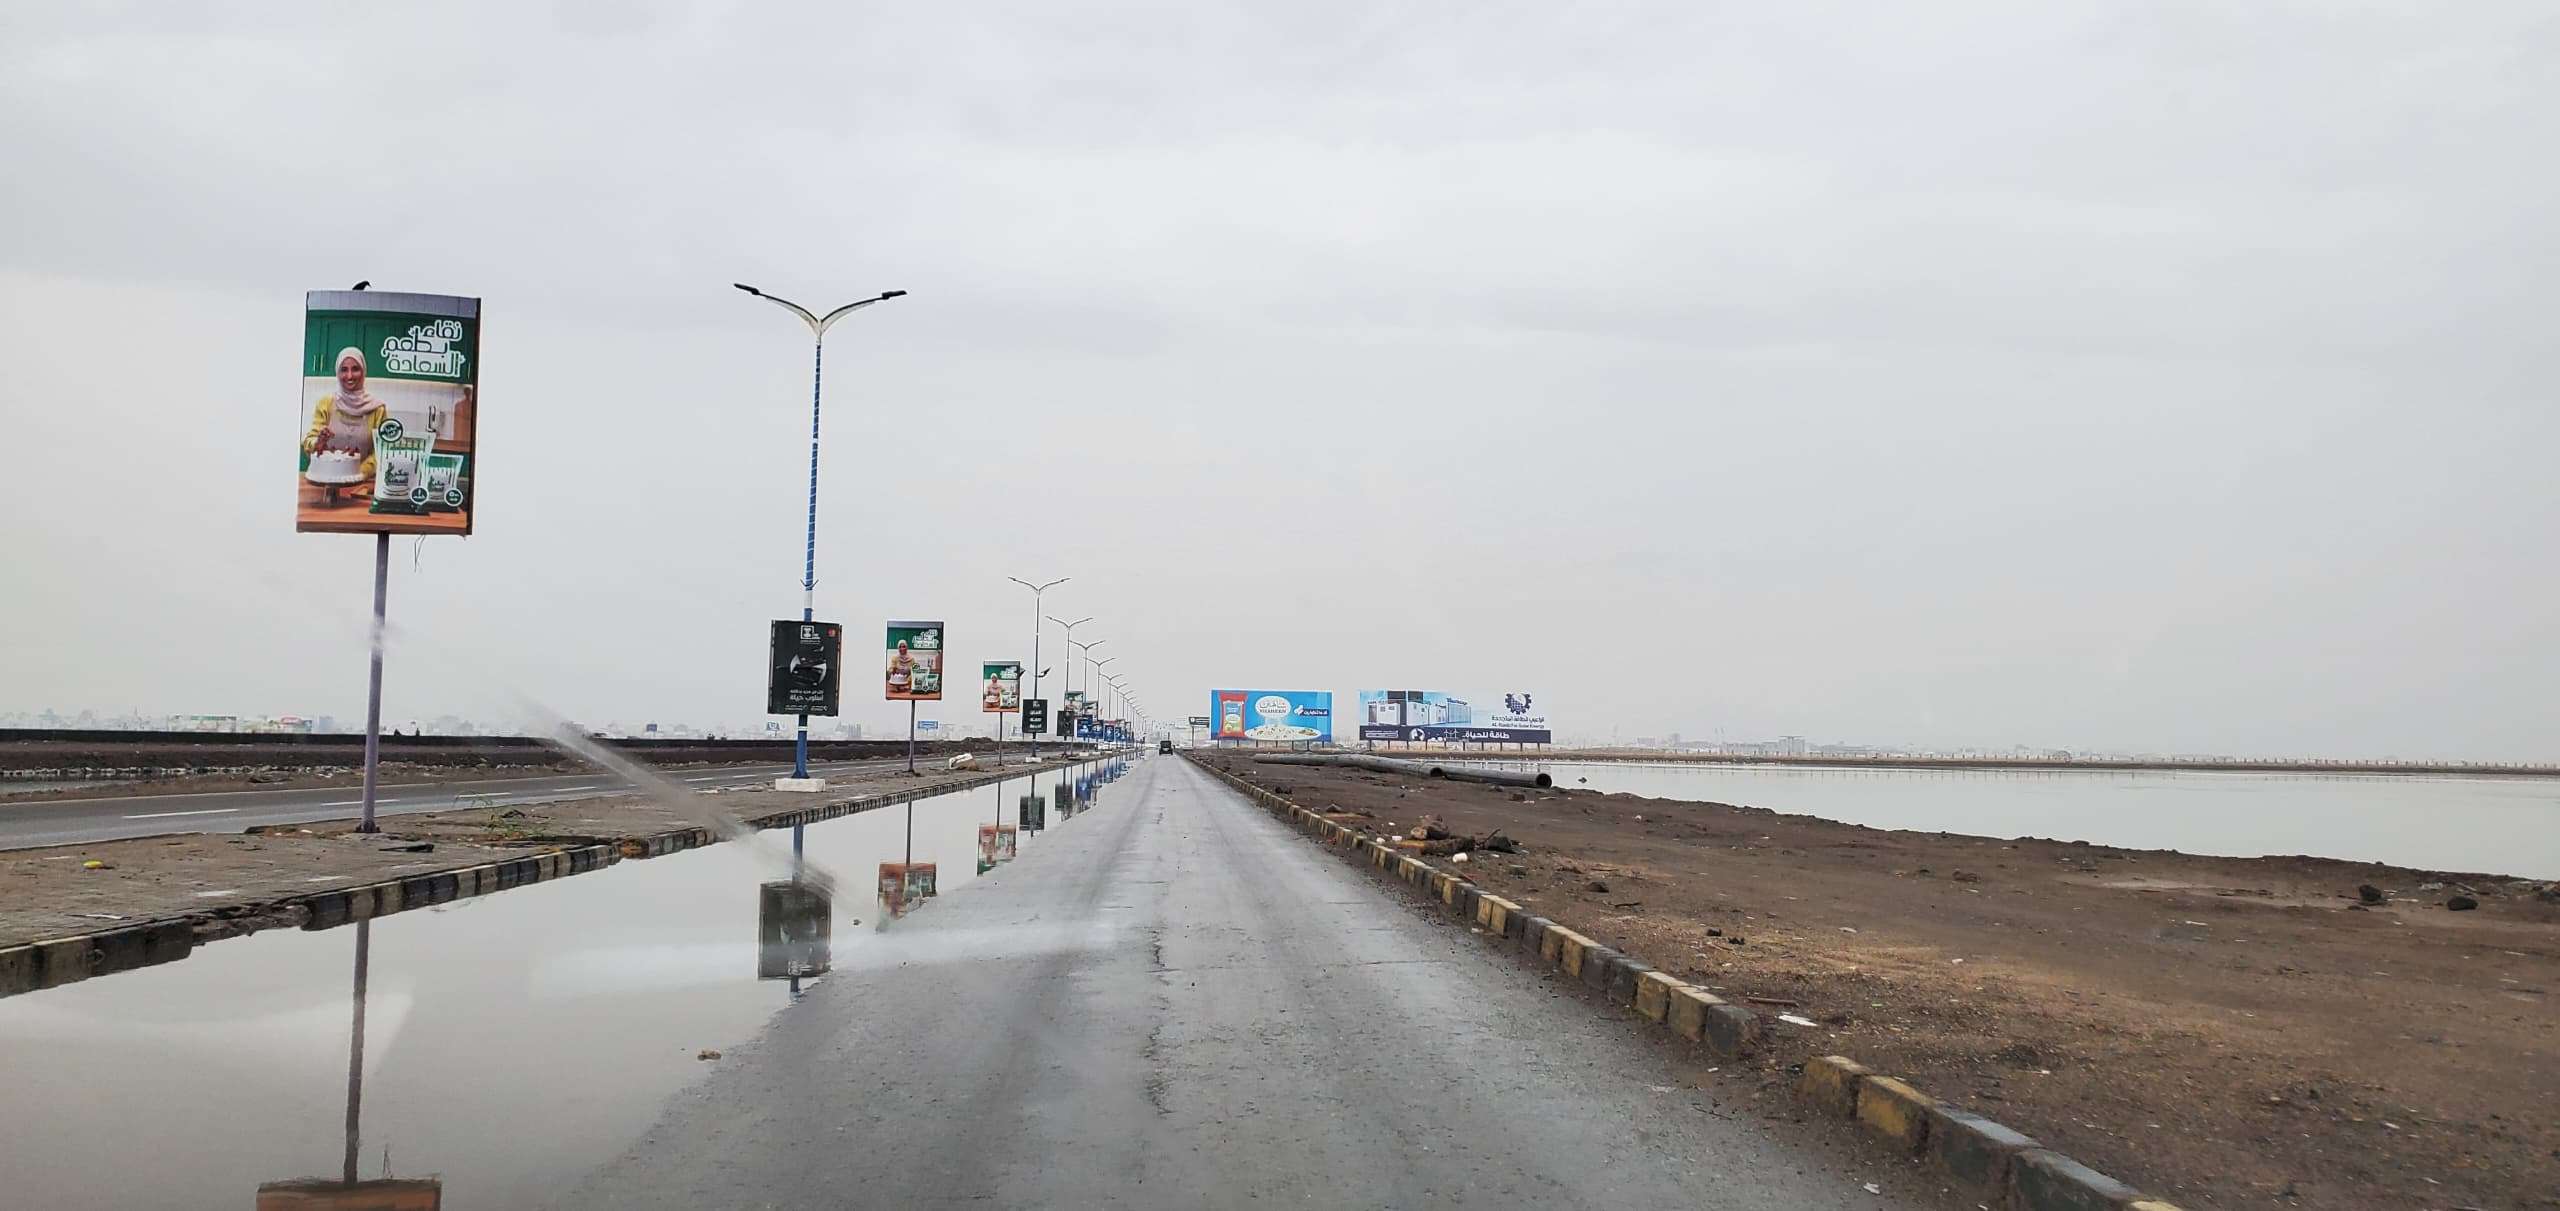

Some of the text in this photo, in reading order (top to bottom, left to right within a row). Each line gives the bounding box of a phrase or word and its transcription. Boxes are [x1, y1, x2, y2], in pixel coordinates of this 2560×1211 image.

[383, 327, 449, 358] بطعم
[388, 354, 460, 375] السعادة
[1489, 730, 1510, 739] طاقة
